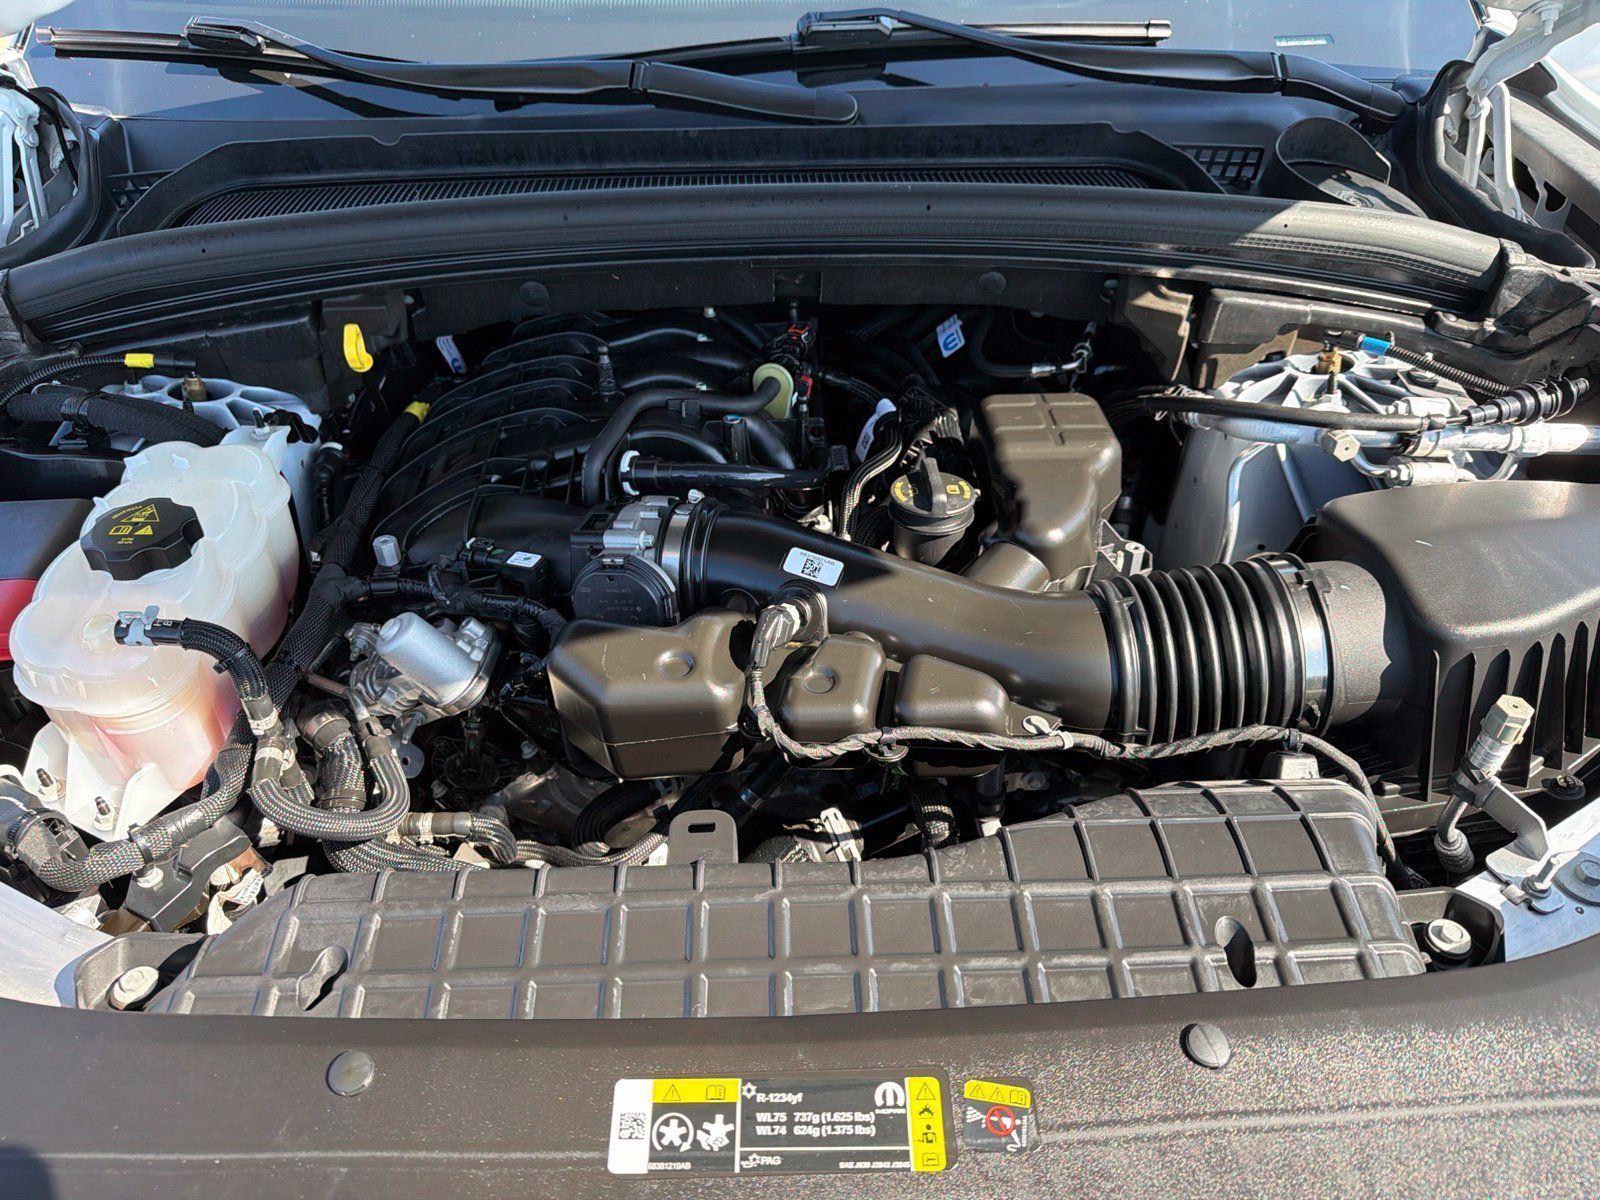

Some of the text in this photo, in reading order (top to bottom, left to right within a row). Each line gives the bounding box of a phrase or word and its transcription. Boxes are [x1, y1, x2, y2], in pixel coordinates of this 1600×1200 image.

[756, 1092, 803, 1105] R-1234yf
[755, 1111, 876, 1124] WL75 737g (1.625 lbs)
[755, 1124, 876, 1137] WL74 624g (1.375 lbs)
[760, 1156, 782, 1165] PAG
